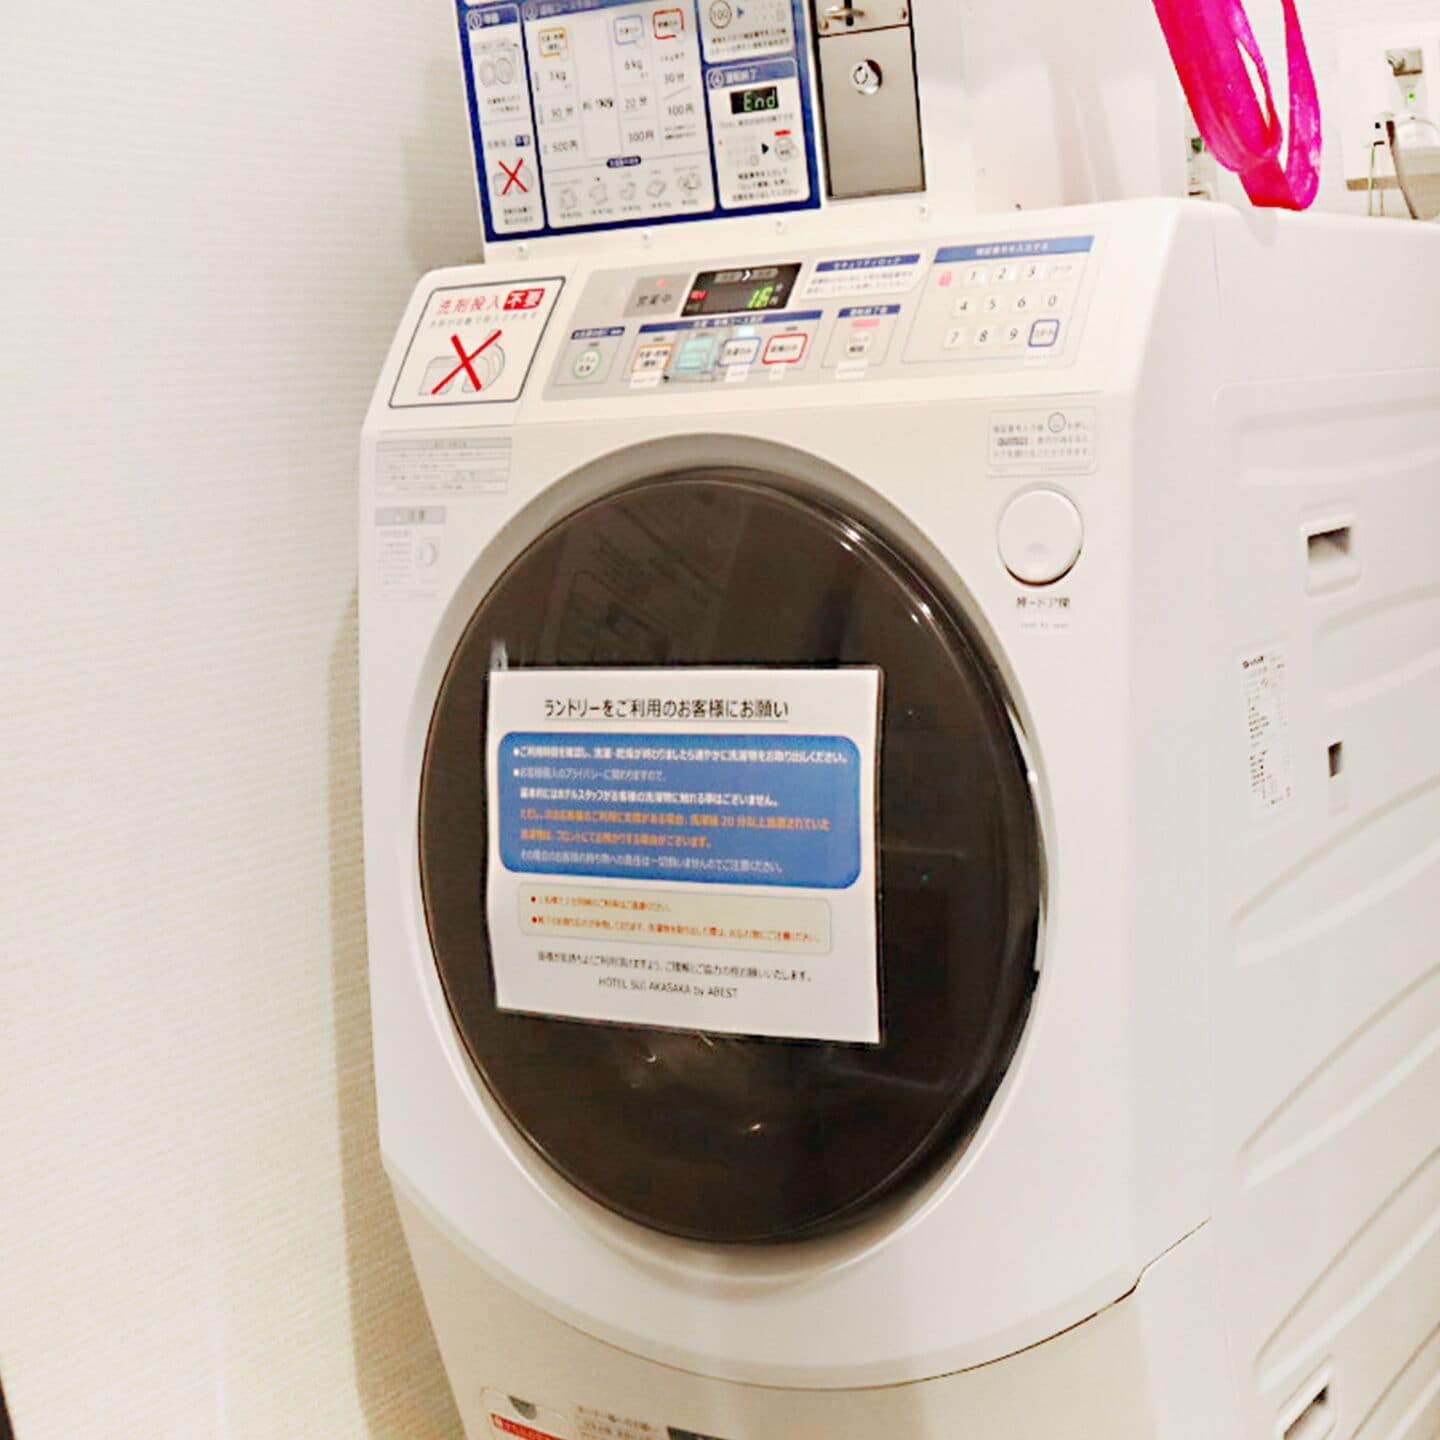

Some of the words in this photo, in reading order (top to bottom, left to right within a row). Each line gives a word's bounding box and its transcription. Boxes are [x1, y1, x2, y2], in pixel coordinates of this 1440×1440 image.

[743, 85, 777, 112] End
[969, 270, 977, 281] 1
[998, 267, 1007, 280] 2
[1028, 265, 1037, 278] 3
[988, 298, 997, 310] 5
[1017, 297, 1026, 309] 6
[1047, 294, 1057, 307] 0
[979, 329, 989, 342] 8
[1009, 327, 1019, 340] 9
[598, 977, 628, 990] HOTEL
[648, 980, 690, 994] AKASAKA
[707, 986, 739, 999] ABEST
